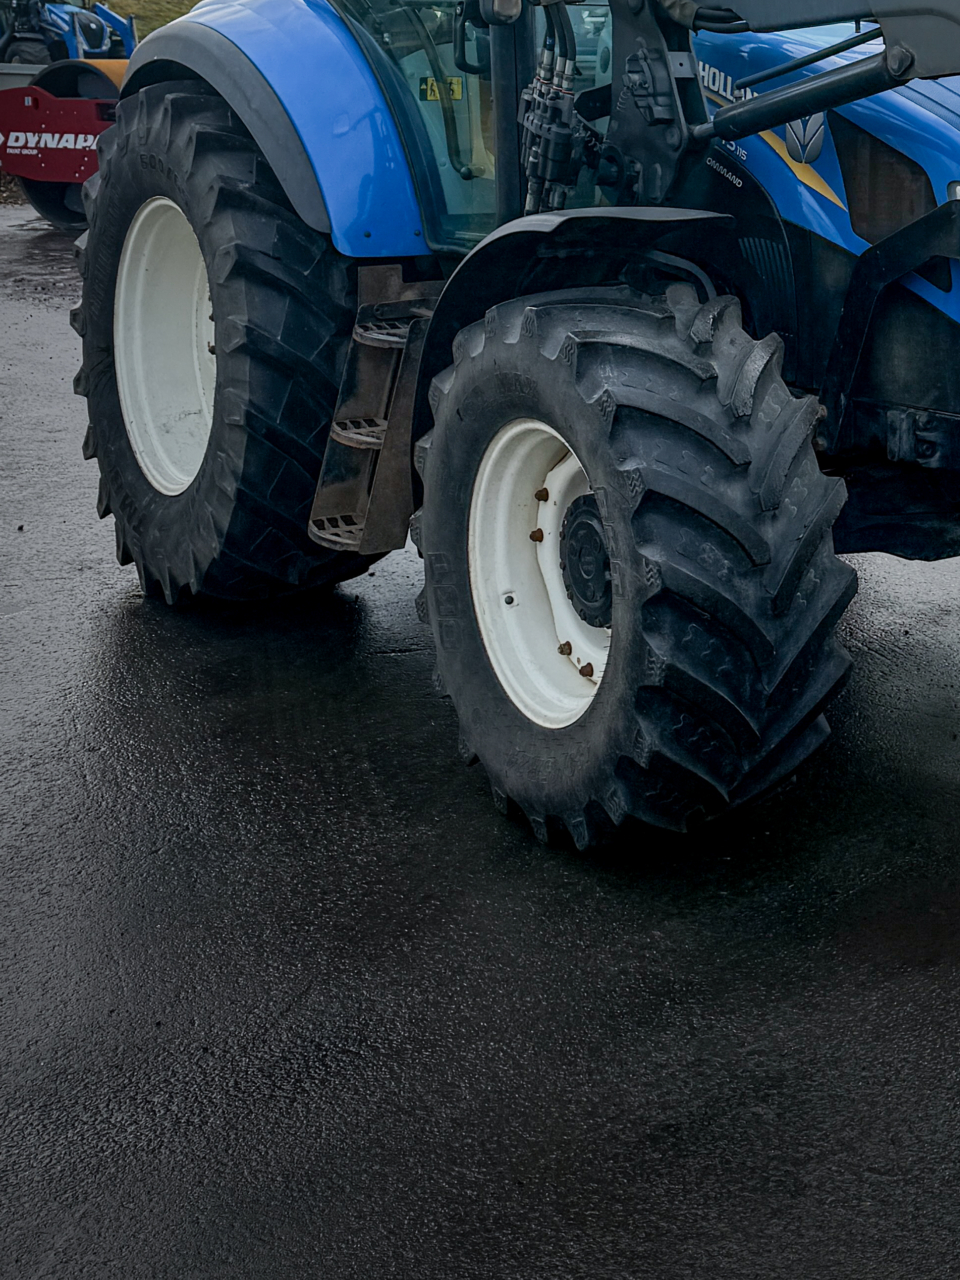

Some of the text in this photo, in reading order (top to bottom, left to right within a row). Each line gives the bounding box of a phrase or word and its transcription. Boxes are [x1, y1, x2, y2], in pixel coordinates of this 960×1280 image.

[698, 61, 760, 103] HOLLN
[6, 131, 100, 150] DYNAP
[706, 157, 743, 188] OMMAND
